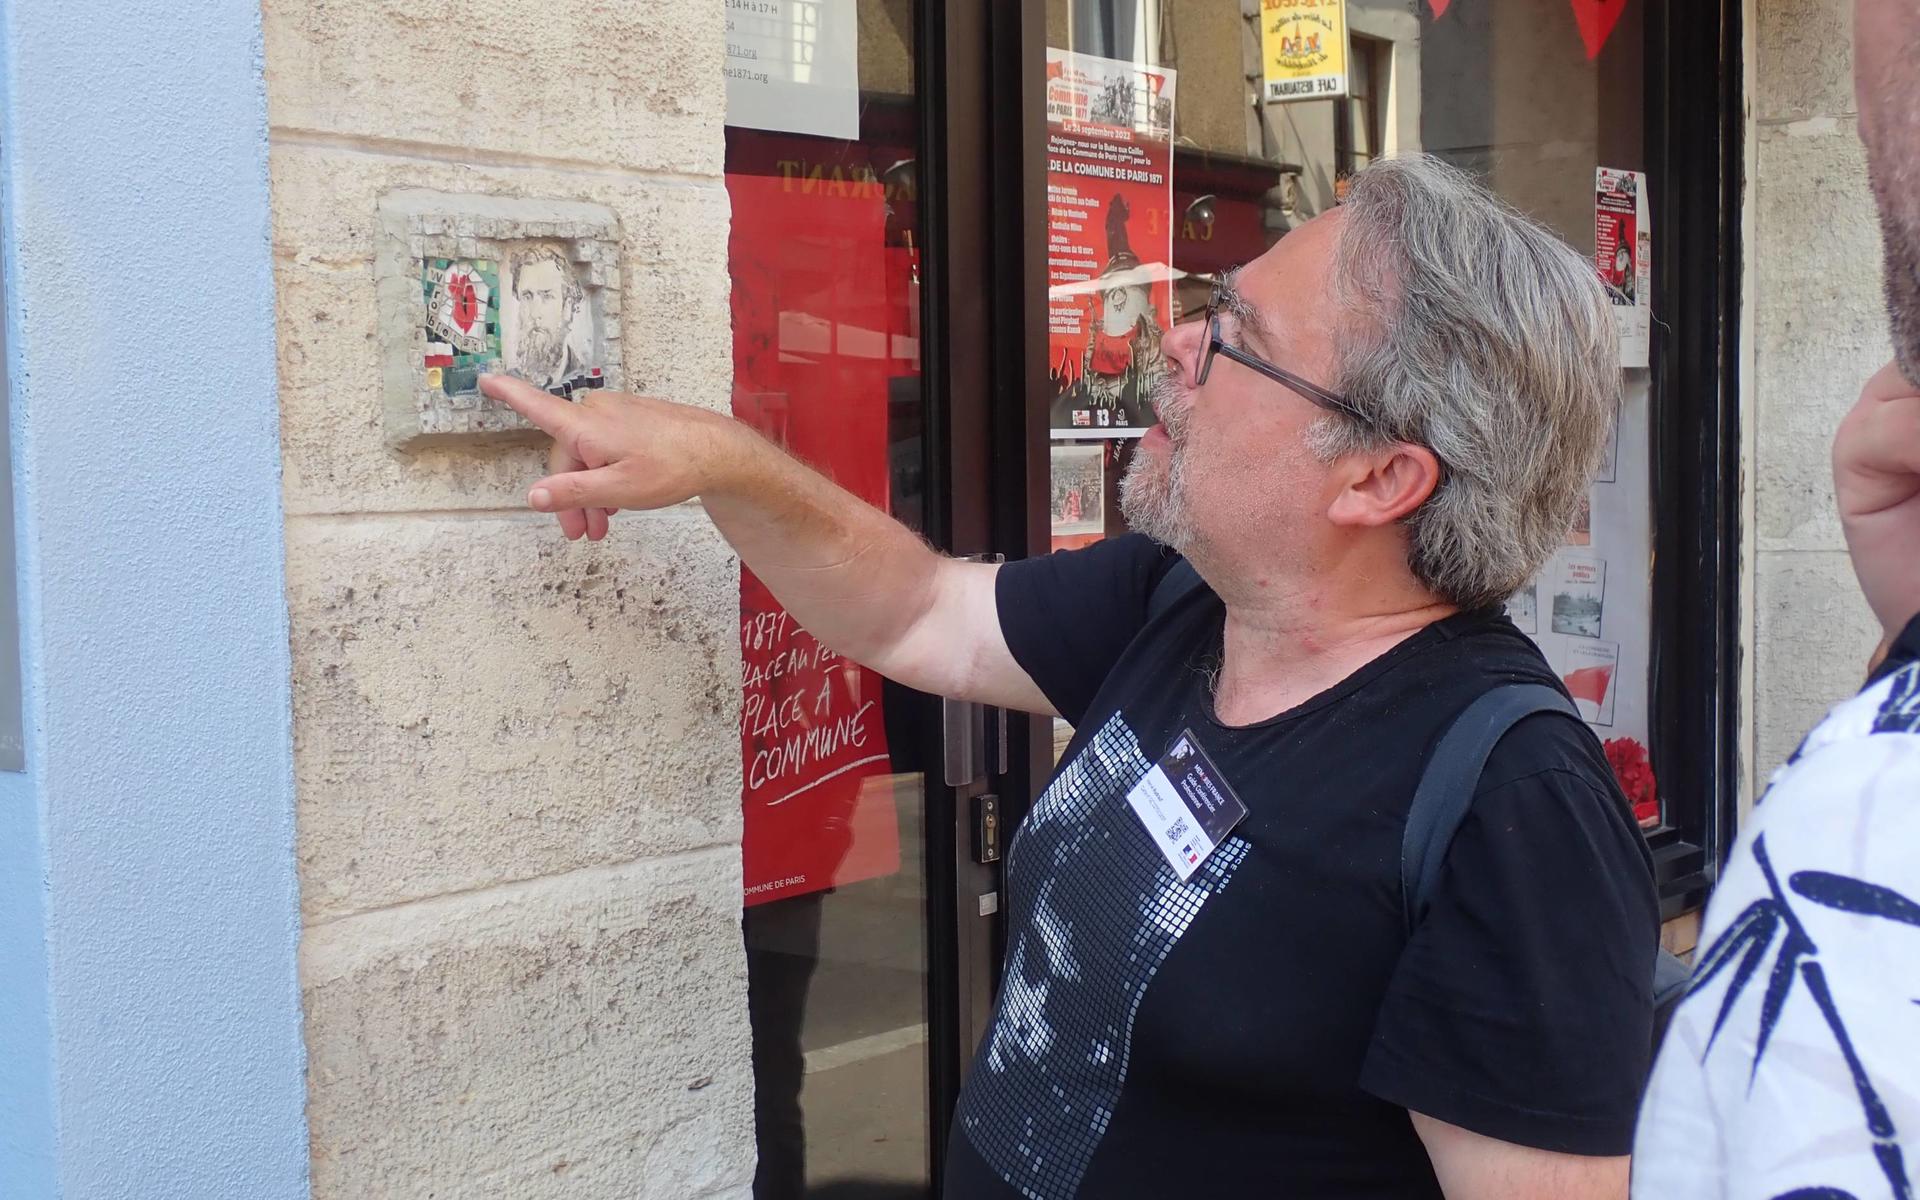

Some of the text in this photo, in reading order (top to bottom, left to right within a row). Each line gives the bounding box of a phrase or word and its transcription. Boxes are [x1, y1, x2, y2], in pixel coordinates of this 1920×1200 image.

[743, 0, 750, 10] H
[759, 3, 769, 13] 17
[771, 5, 778, 14] H
[1063, 120, 1072, 131] Le
[1081, 125, 1114, 139] septembre
[1072, 147, 1098, 158] Commune
[1105, 151, 1118, 161] Paris
[1133, 157, 1145, 166] pour
[1050, 159, 1163, 185] DE LA COMMUNE DE PARIS 1871
[743, 610, 787, 650] 1871
[787, 648, 808, 676] AU
[741, 688, 806, 738] PLACE
[749, 700, 875, 790] COMMUNE
[1186, 772, 1199, 788] Guide
[1230, 842, 1252, 871] SINCE
[744, 874, 806, 896] OMMUNE DE PARIS
